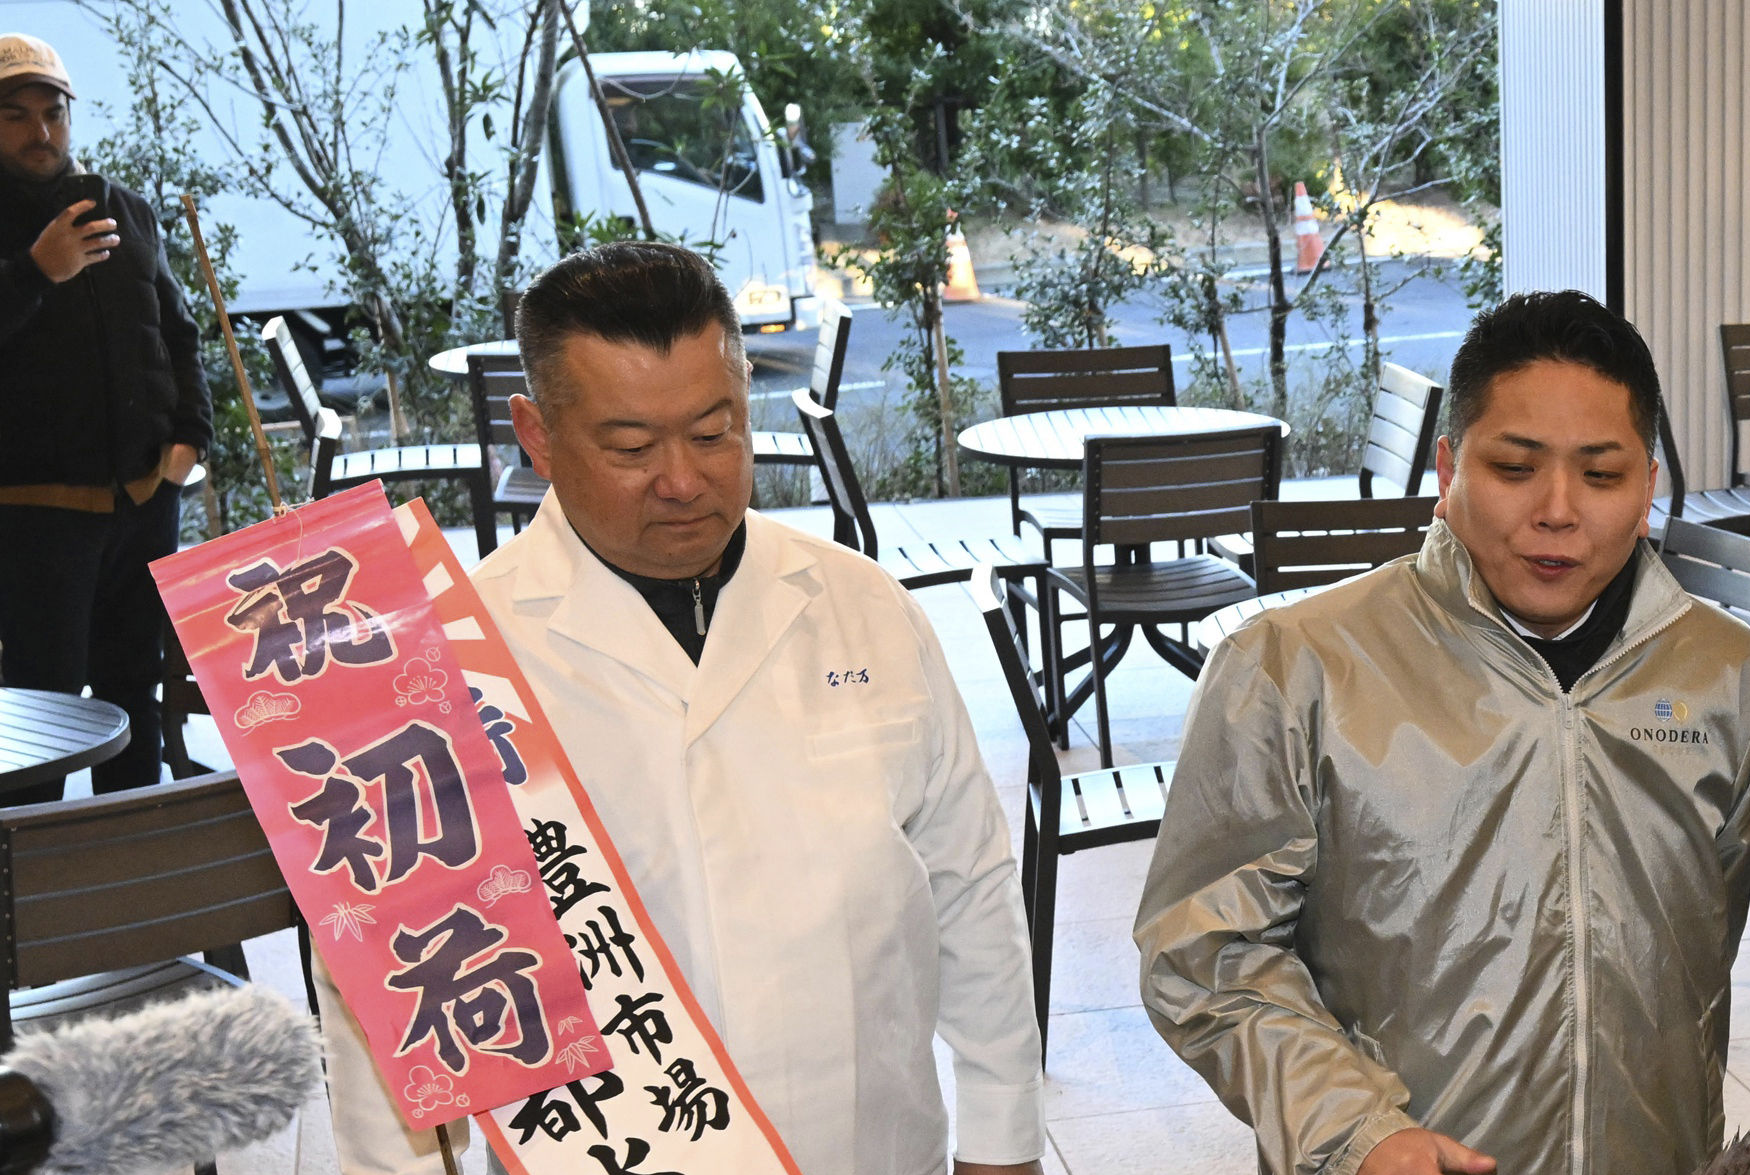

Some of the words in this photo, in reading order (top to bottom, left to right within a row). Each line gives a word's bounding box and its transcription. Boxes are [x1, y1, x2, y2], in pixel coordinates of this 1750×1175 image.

[826, 668, 869, 687] なだ万
[1630, 728, 1709, 744] ONODERA
[226, 546, 554, 1078] 祝初荷
[524, 818, 731, 1142] 豊洲市場
